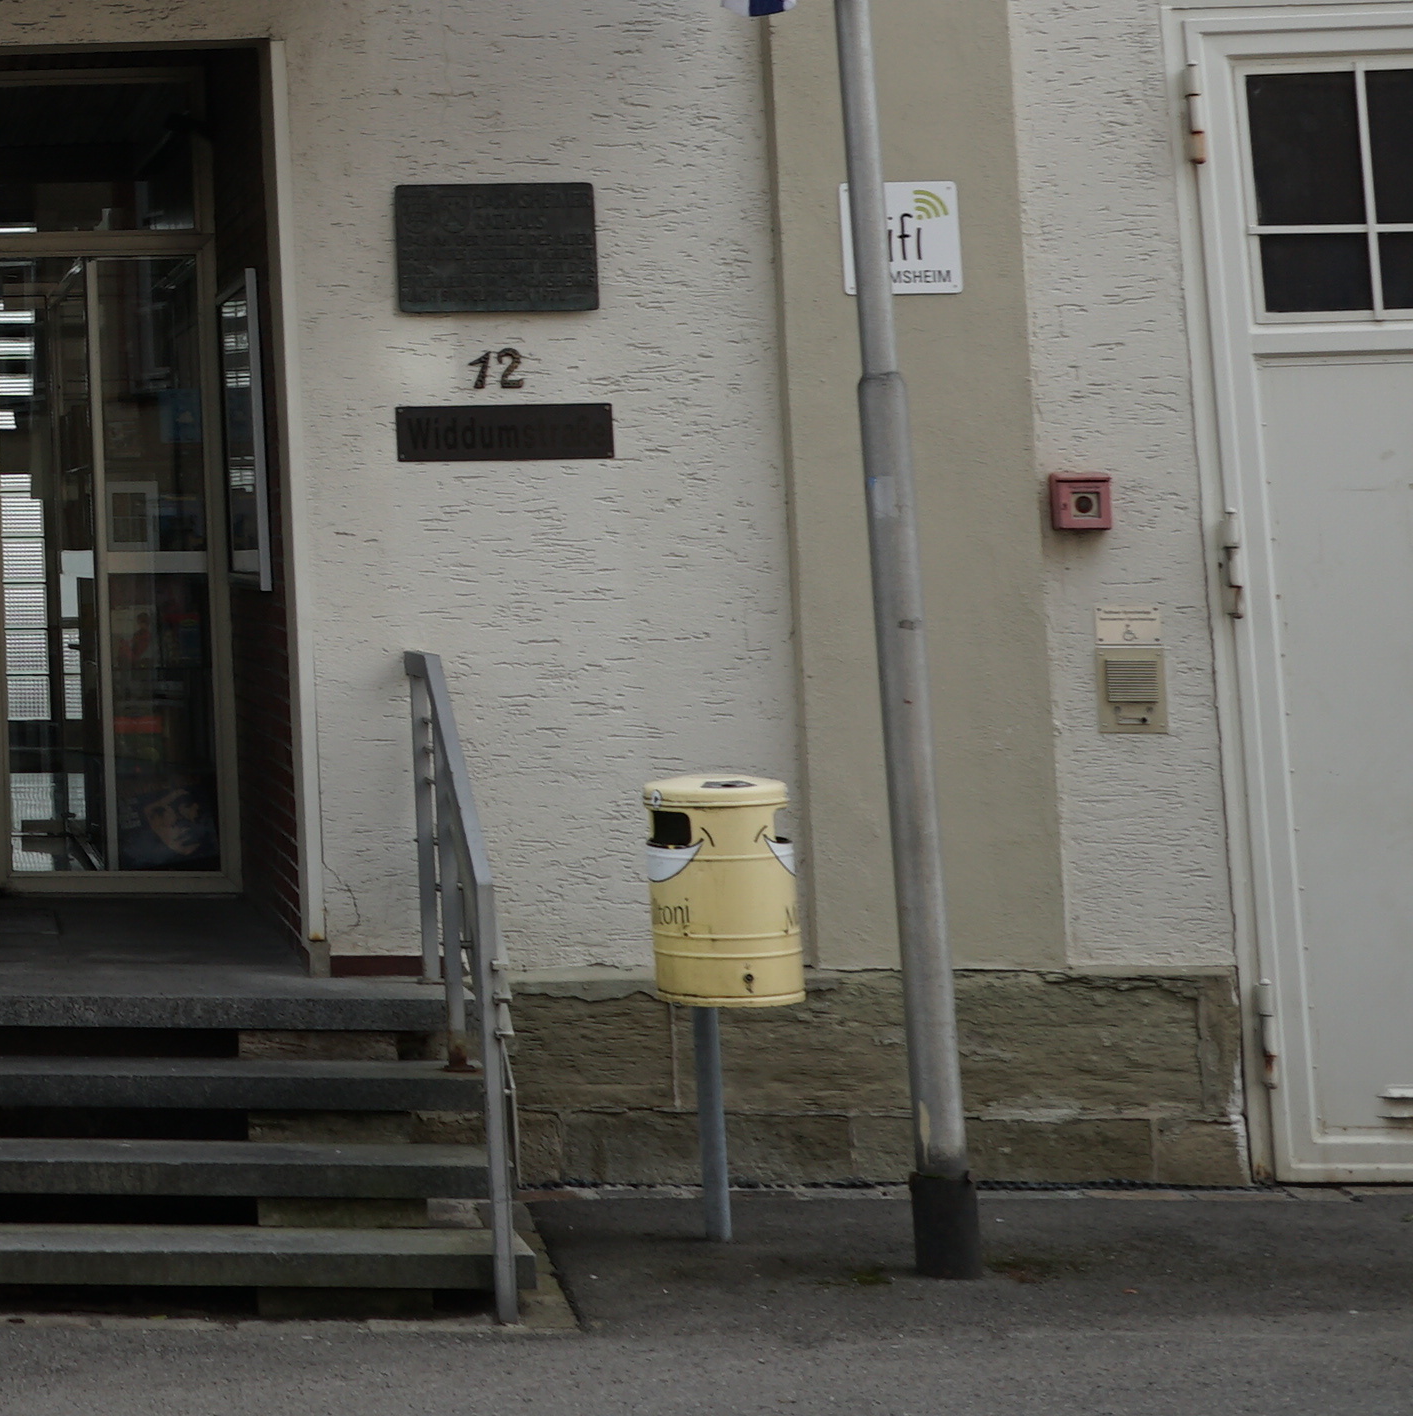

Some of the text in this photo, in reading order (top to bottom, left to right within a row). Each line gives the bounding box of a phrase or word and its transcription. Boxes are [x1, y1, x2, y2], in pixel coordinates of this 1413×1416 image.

[886, 212, 923, 262] ifi
[889, 269, 952, 283] MSHEIM
[468, 347, 524, 389] 12
